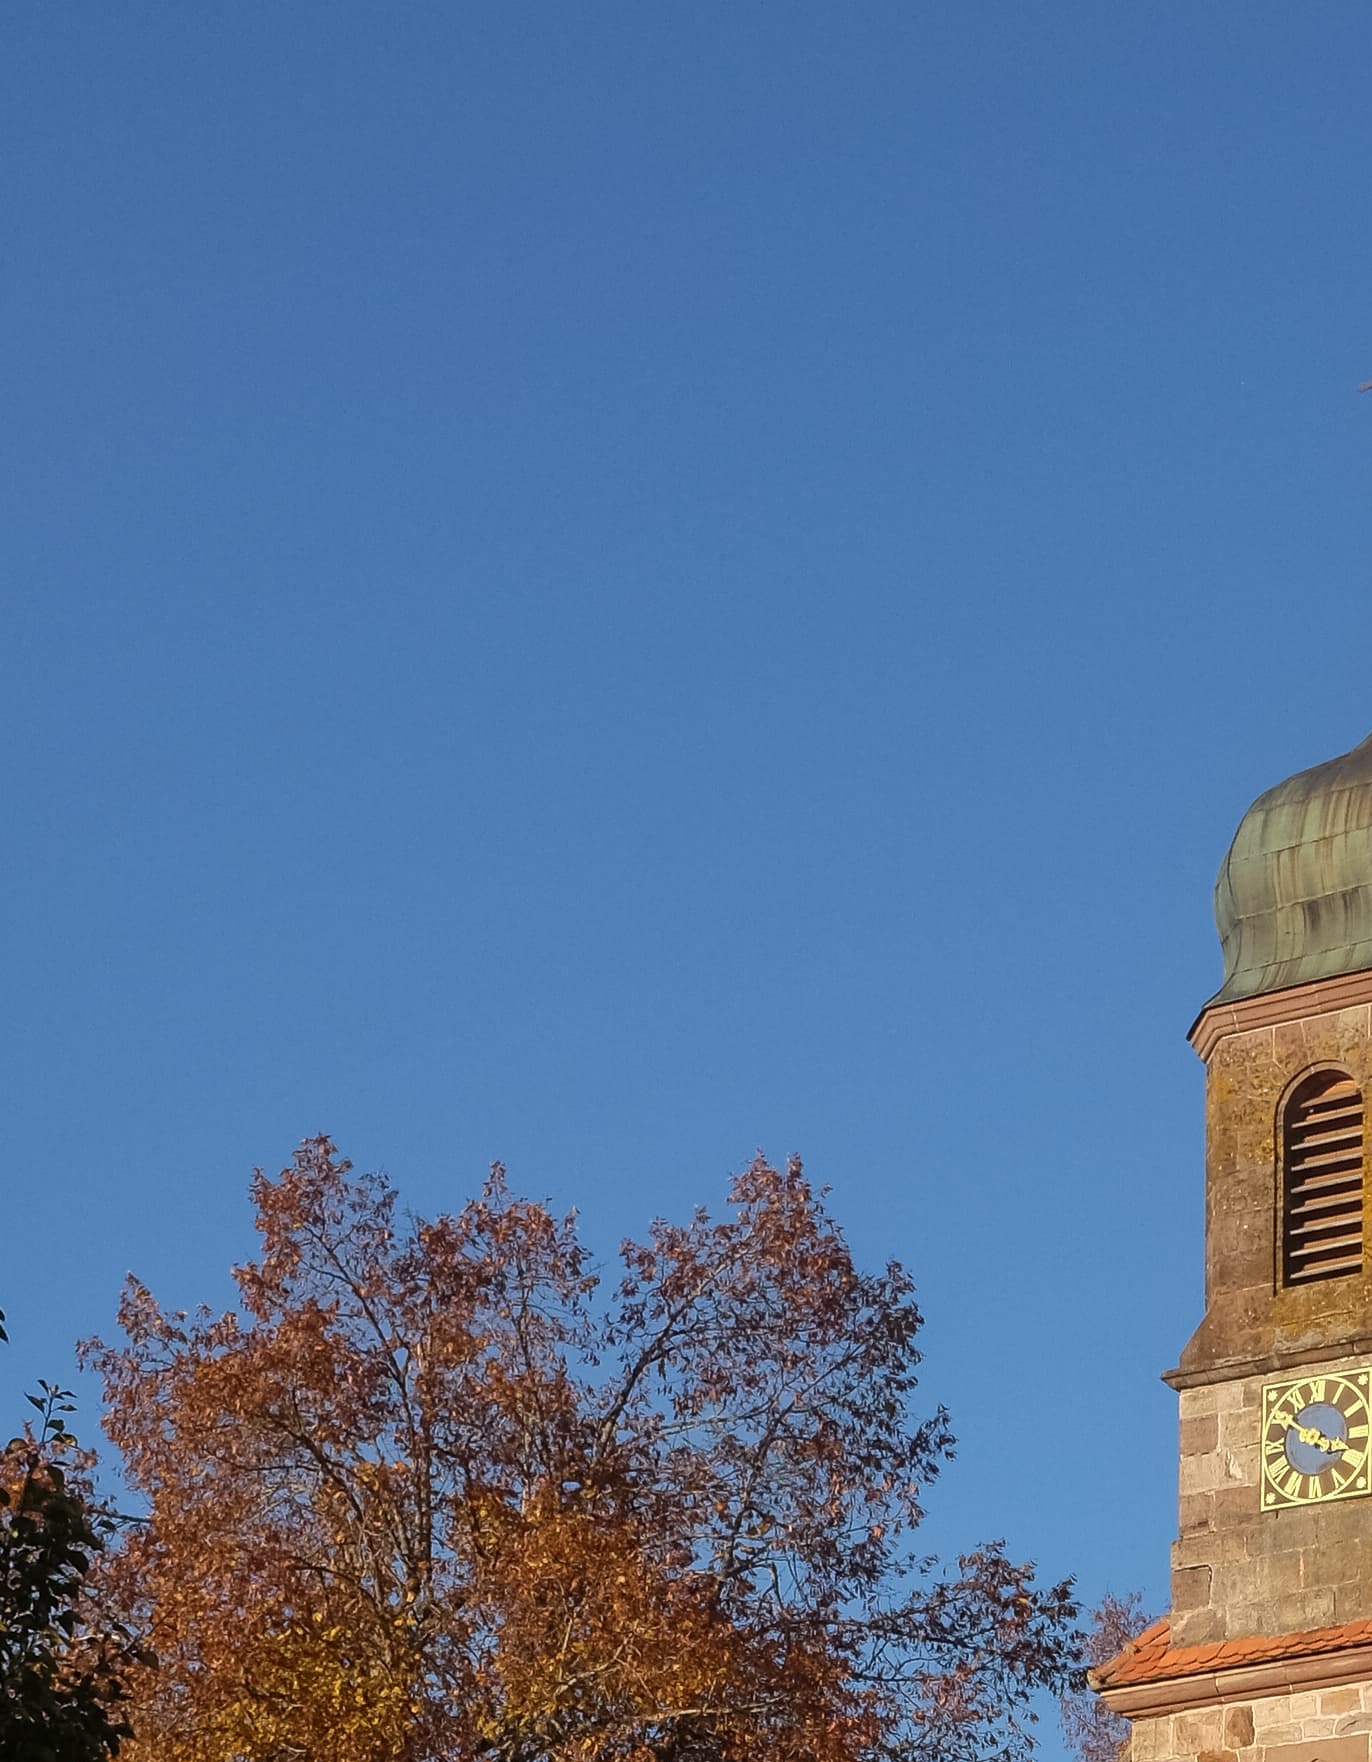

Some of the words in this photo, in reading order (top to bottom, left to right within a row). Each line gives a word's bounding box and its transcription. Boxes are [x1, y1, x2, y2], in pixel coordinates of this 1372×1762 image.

[1286, 1389, 1306, 1414] XI
[1309, 1380, 1326, 1404] XII
[1332, 1383, 1345, 1405] I
[1344, 1399, 1363, 1418] II
[1348, 1424, 1369, 1439] III
[1265, 1437, 1285, 1456] IX
[1268, 1454, 1290, 1483] VIII
[1331, 1467, 1346, 1489] V
[1284, 1470, 1303, 1497] VII
[1309, 1475, 1322, 1499] VI
